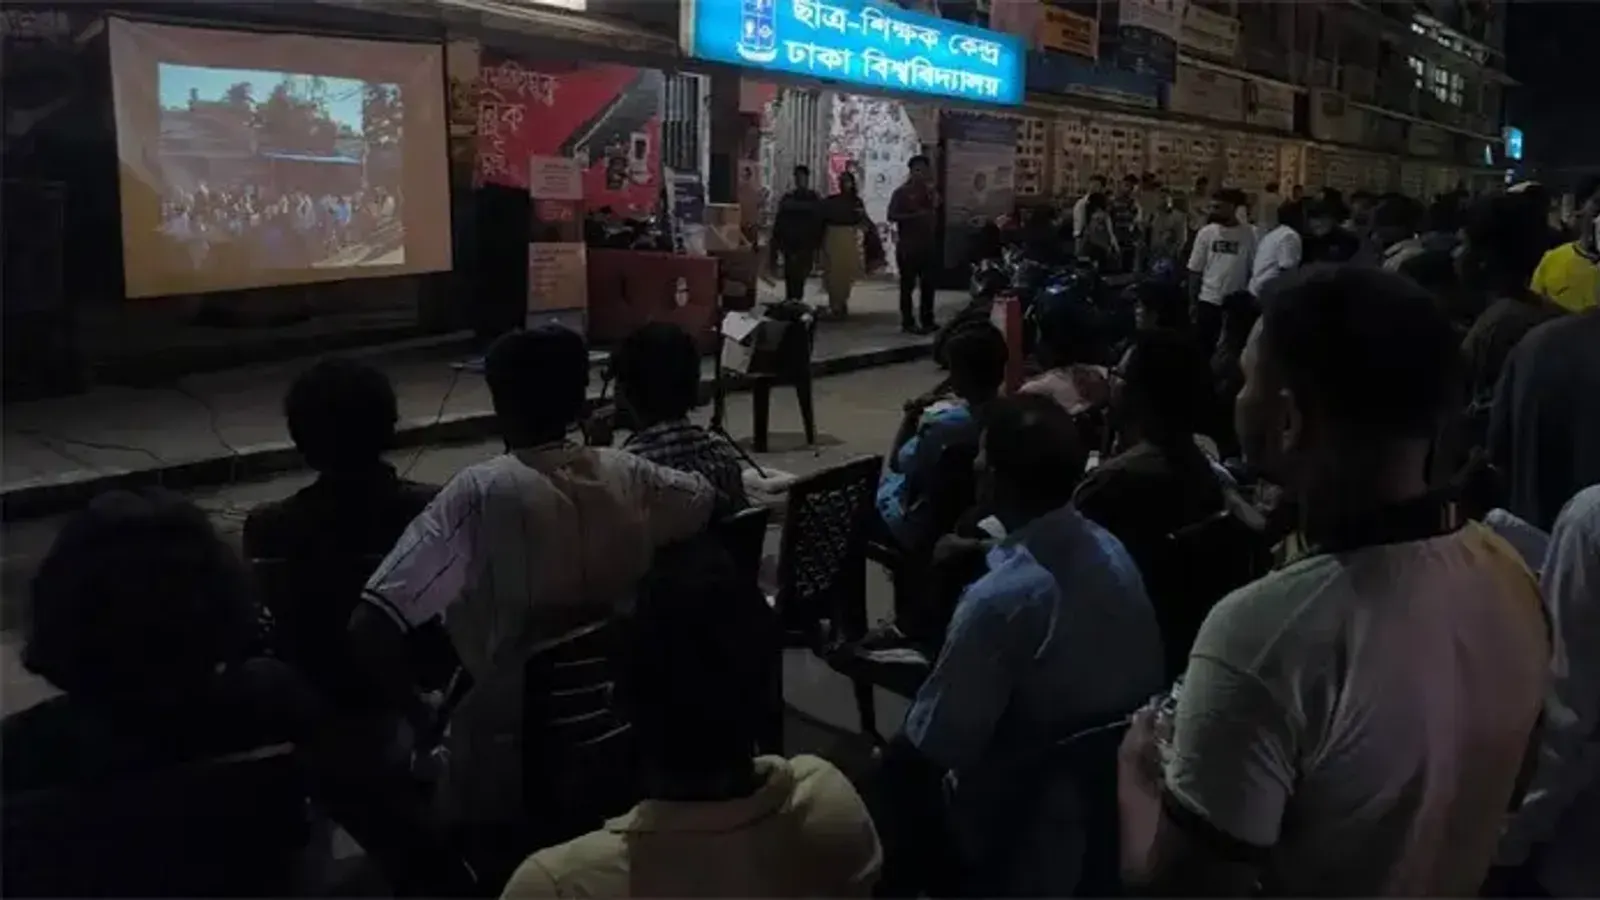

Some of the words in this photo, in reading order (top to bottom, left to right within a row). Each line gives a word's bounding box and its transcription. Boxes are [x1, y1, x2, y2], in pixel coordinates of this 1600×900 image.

[793, 0, 940, 50] ছাত্র-শিক্ষক
[949, 35, 1001, 66] কেন্দ্র
[785, 41, 853, 75] ঢাকা
[863, 49, 1001, 96] বিশ্ববিদ্যালয়
